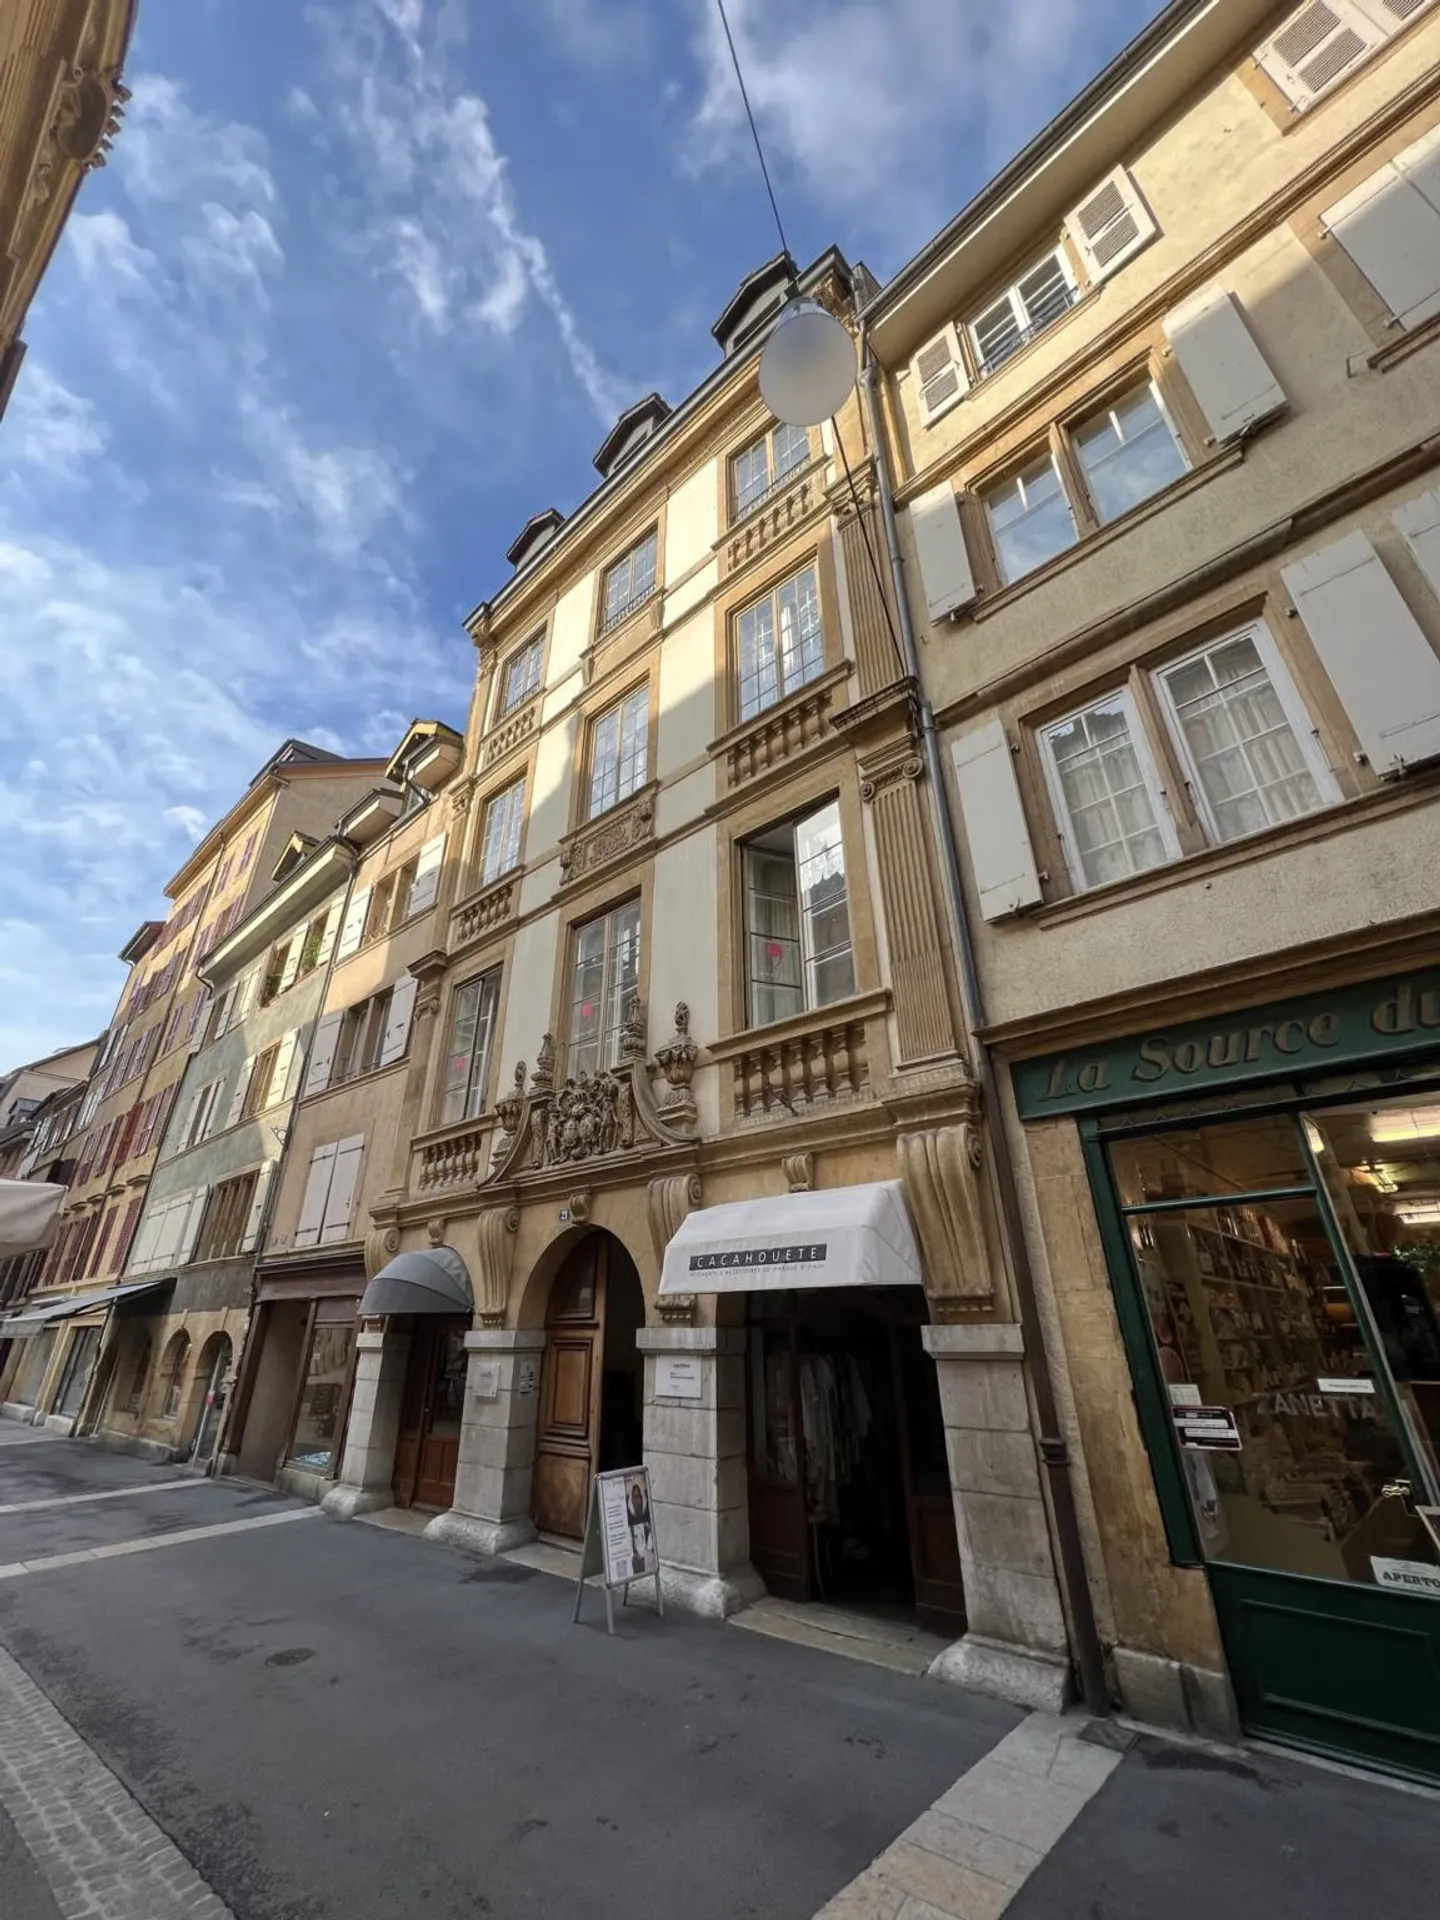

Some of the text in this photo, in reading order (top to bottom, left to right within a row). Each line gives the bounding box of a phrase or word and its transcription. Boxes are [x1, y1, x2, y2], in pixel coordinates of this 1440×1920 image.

[1037, 1057, 1110, 1102] La
[1131, 1012, 1341, 1083] Source
[696, 1246, 817, 1269] CACAHOUETE
[1382, 1570, 1440, 1588] APERTO
